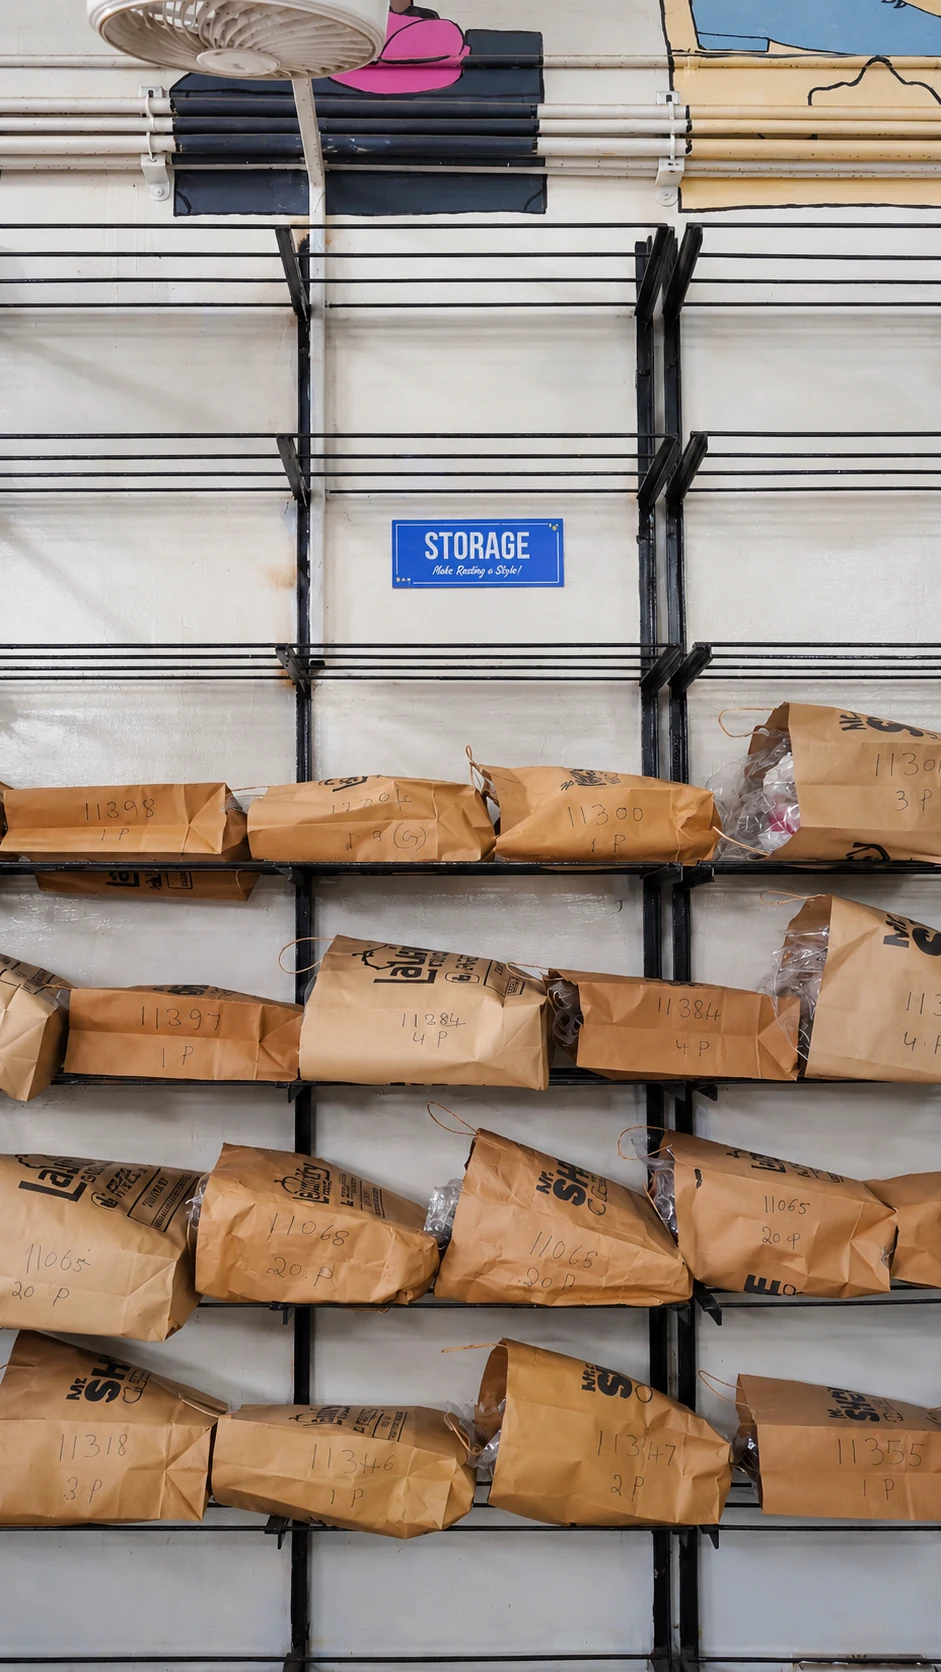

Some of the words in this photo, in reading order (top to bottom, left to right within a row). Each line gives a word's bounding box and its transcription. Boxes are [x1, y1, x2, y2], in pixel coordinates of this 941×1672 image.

[424, 531, 531, 560] STORAGE
[495, 564, 523, 578] Style!
[85, 798, 156, 821] 11398
[894, 790, 909, 812] 3
[920, 789, 933, 811] P
[567, 803, 644, 828] 11300
[118, 827, 130, 841] P
[613, 834, 627, 853] P
[140, 1006, 222, 1031] 11397
[657, 996, 722, 1022] 11384
[412, 1031, 426, 1045] 4
[436, 1030, 448, 1048] P
[675, 1039, 687, 1055] 4
[698, 1040, 710, 1057] P
[181, 1045, 195, 1066] P
[764, 1195, 811, 1215] 11065
[761, 1226, 781, 1244] 20
[313, 1265, 334, 1287] P
[11, 1280, 35, 1300] 20
[52, 1287, 70, 1307] P
[59, 1433, 128, 1461] 11318
[837, 1437, 926, 1468] 11355
[63, 1476, 78, 1500] 3
[89, 1479, 103, 1503] P
[350, 1488, 364, 1508] P
[609, 1473, 623, 1497] 2
[631, 1475, 645, 1501] P
[883, 1478, 895, 1501] P
